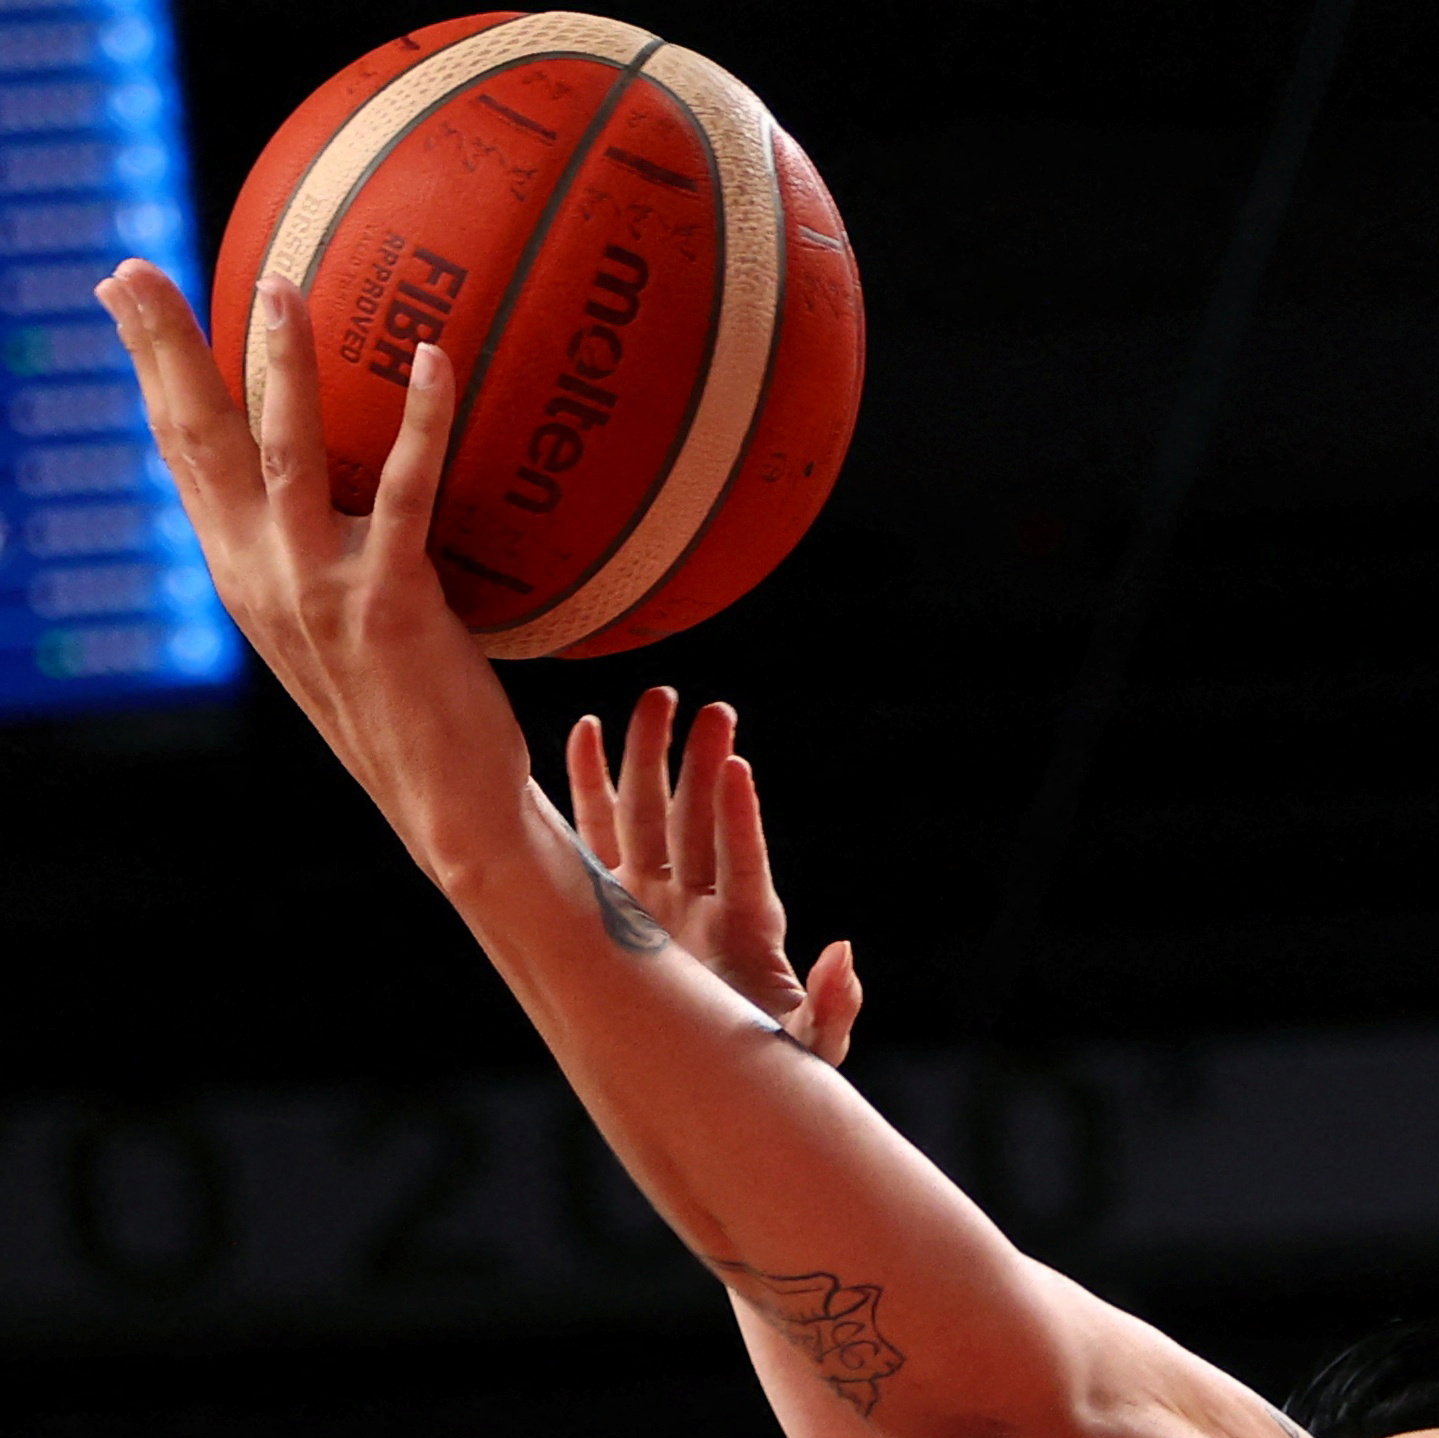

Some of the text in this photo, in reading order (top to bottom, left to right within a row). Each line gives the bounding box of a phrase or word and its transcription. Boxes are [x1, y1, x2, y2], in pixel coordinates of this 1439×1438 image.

[340, 232, 406, 365] APPROVED
[369, 246, 469, 388] FIBA
[503, 243, 650, 515] molten
